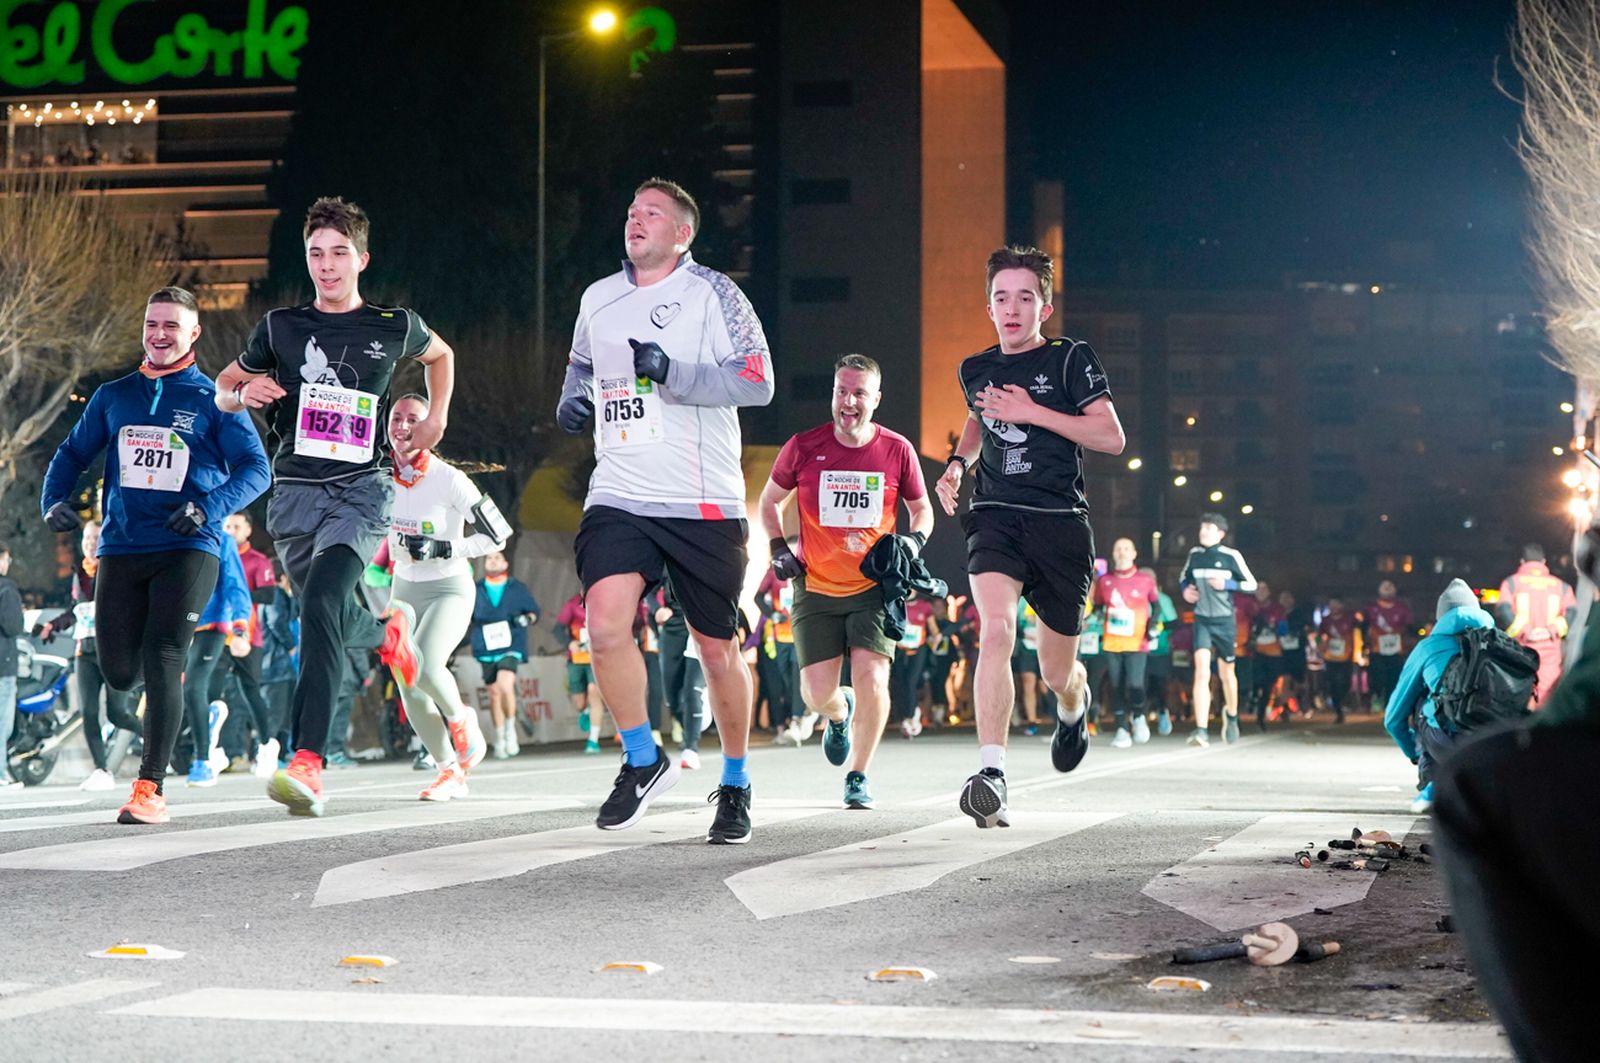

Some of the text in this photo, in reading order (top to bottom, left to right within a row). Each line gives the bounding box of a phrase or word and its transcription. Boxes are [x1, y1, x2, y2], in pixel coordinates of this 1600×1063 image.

[91, 0, 310, 84] Corte
[308, 400, 323, 409] SAN
[319, 393, 352, 404] NOCHE DE
[604, 397, 645, 422] 6753
[127, 439, 140, 447] SAN
[156, 433, 164, 441] DE
[134, 448, 173, 469] 2871
[833, 491, 870, 509] 7705
